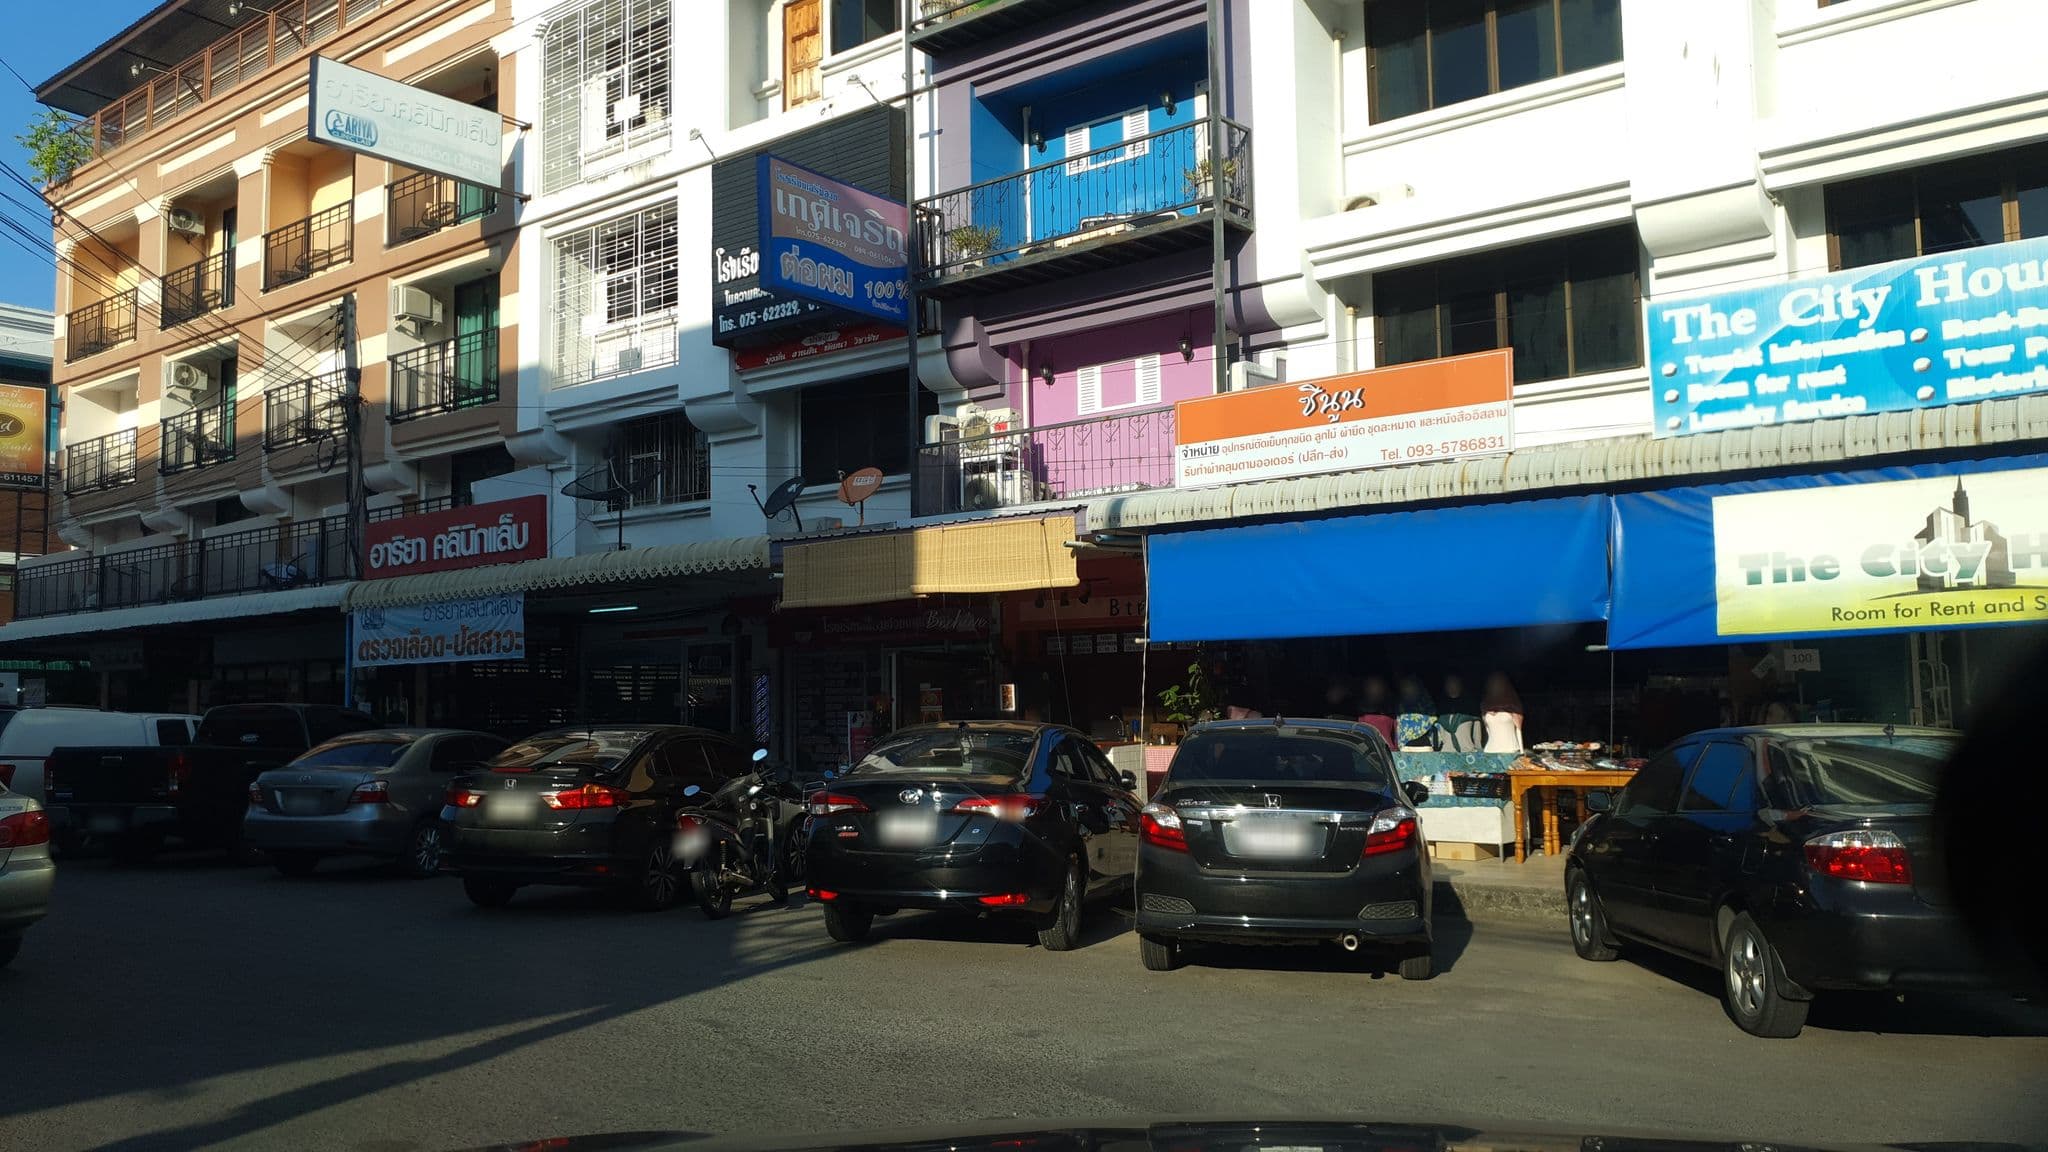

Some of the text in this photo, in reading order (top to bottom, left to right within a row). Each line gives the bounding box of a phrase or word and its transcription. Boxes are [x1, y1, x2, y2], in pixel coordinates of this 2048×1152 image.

[344, 116, 373, 139] ARIYA
[780, 245, 909, 300] ต่อผม 100%
[1662, 303, 1757, 345] The
[1778, 283, 1892, 328] City
[1755, 373, 1791, 395] for
[1797, 364, 1846, 390] rent
[1182, 443, 1220, 460] จำหน่าย
[1221, 433, 1312, 454] อุปกรณ์ตัดเย็บทุกชนิด
[1367, 419, 1417, 437] ชุดละหมาด
[1419, 408, 1508, 427] และหนังสืออิสลาม
[1297, 445, 1348, 465] (ปลีก-ส่ง)
[1380, 448, 1402, 461] Tel.
[1406, 435, 1505, 458] 093-5786831
[370, 513, 529, 569] อาริยา คลินิกแล็บ
[1738, 552, 1841, 586] The
[1860, 537, 1991, 583] City
[1832, 605, 1886, 622] Room
[1893, 602, 1921, 619] for
[1930, 600, 1976, 617] Rent
[1984, 595, 2025, 614] and
[357, 624, 524, 661] ตรวจเลือด-ปัสสาวะ
[1792, 653, 1812, 664] 100
